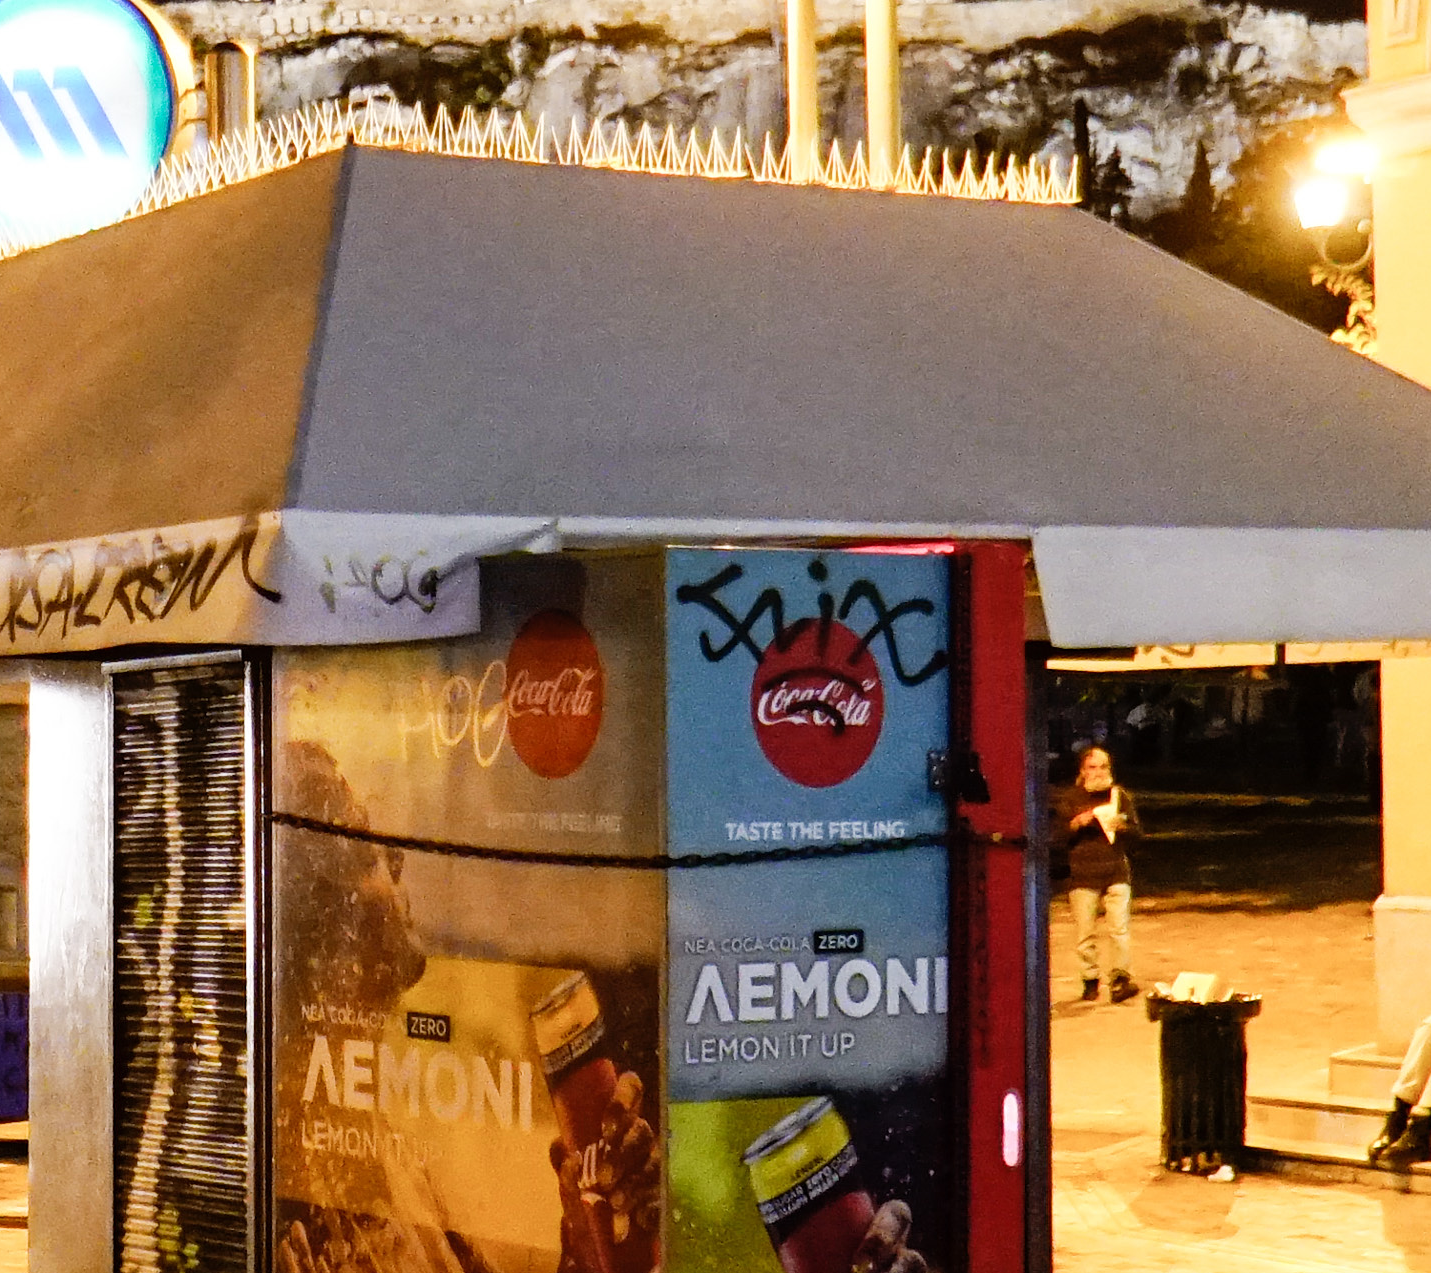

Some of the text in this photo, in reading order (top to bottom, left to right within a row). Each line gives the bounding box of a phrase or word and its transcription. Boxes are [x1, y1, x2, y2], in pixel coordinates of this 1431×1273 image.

[507, 668, 598, 717] Coca-Cola
[725, 820, 906, 842] TASTE THE FEELING
[720, 935, 812, 954] COCA-COLA
[817, 933, 858, 951] ZERO
[409, 1016, 448, 1037] ZERO
[685, 1032, 856, 1065] LEMON IT UP
[302, 1120, 378, 1159] LEMON
